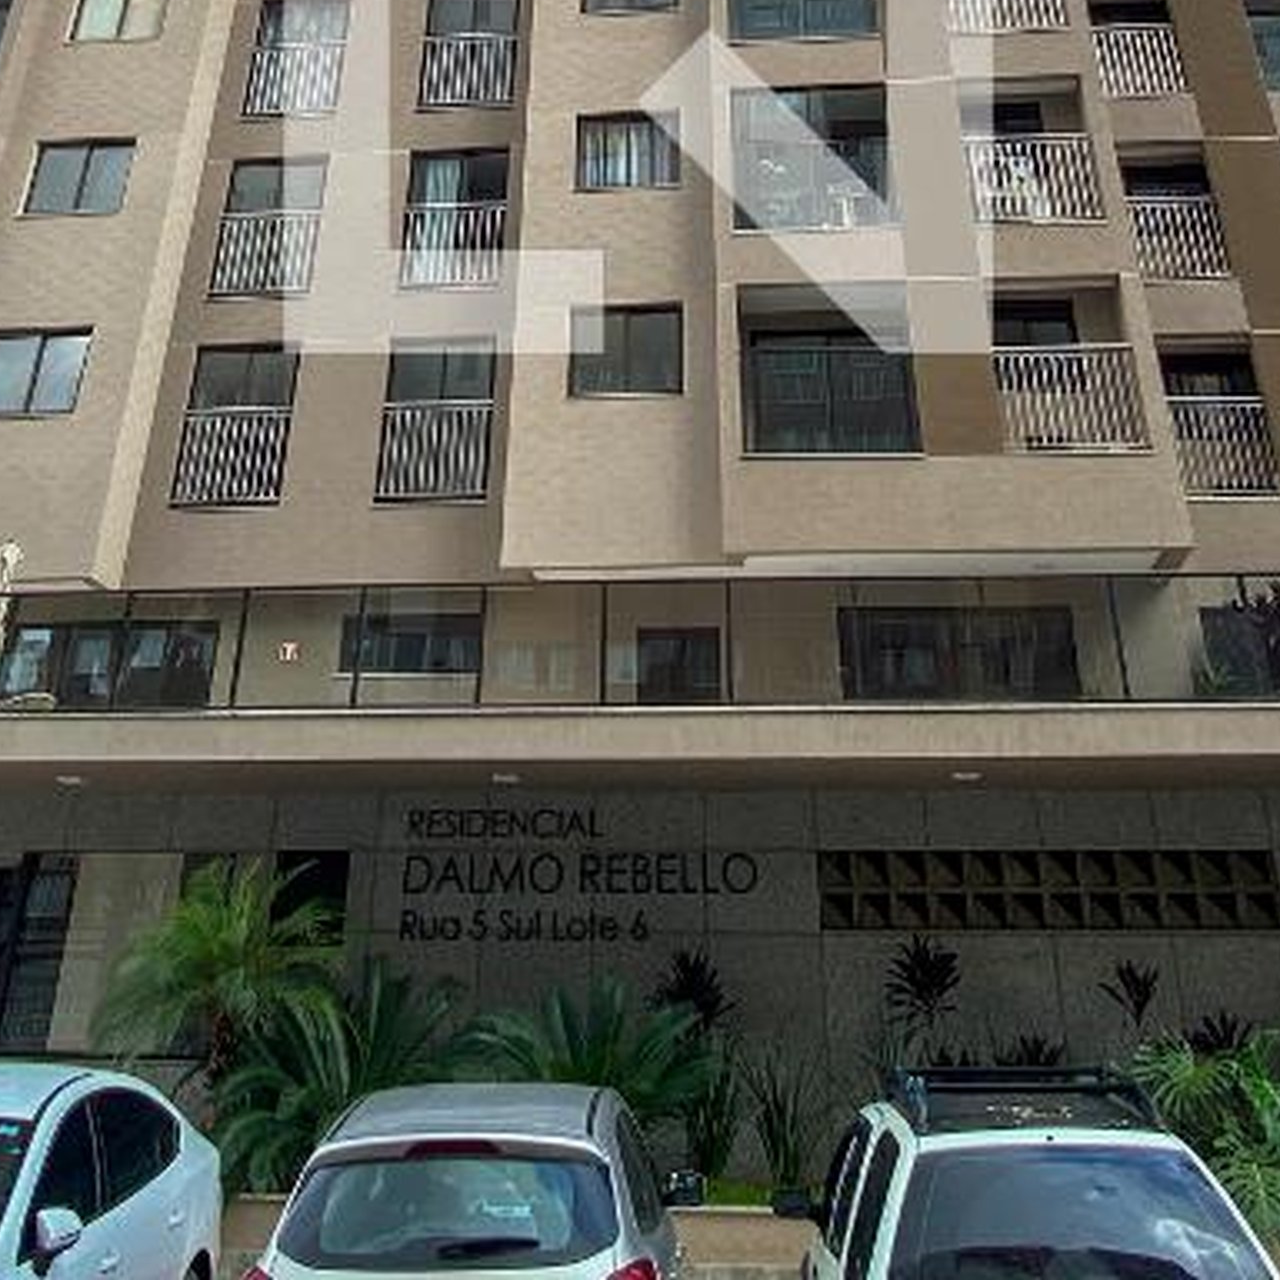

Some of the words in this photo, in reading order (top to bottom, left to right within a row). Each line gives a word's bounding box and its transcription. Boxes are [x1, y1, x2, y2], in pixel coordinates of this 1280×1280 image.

[407, 809, 604, 839] RESIDENCIAL
[402, 854, 563, 895] DALMO
[578, 852, 758, 895] REBELLO
[399, 910, 461, 941] Rua
[467, 911, 488, 941] 5
[497, 909, 541, 941] Sul
[551, 910, 619, 941] Lote
[629, 909, 650, 941] 6
